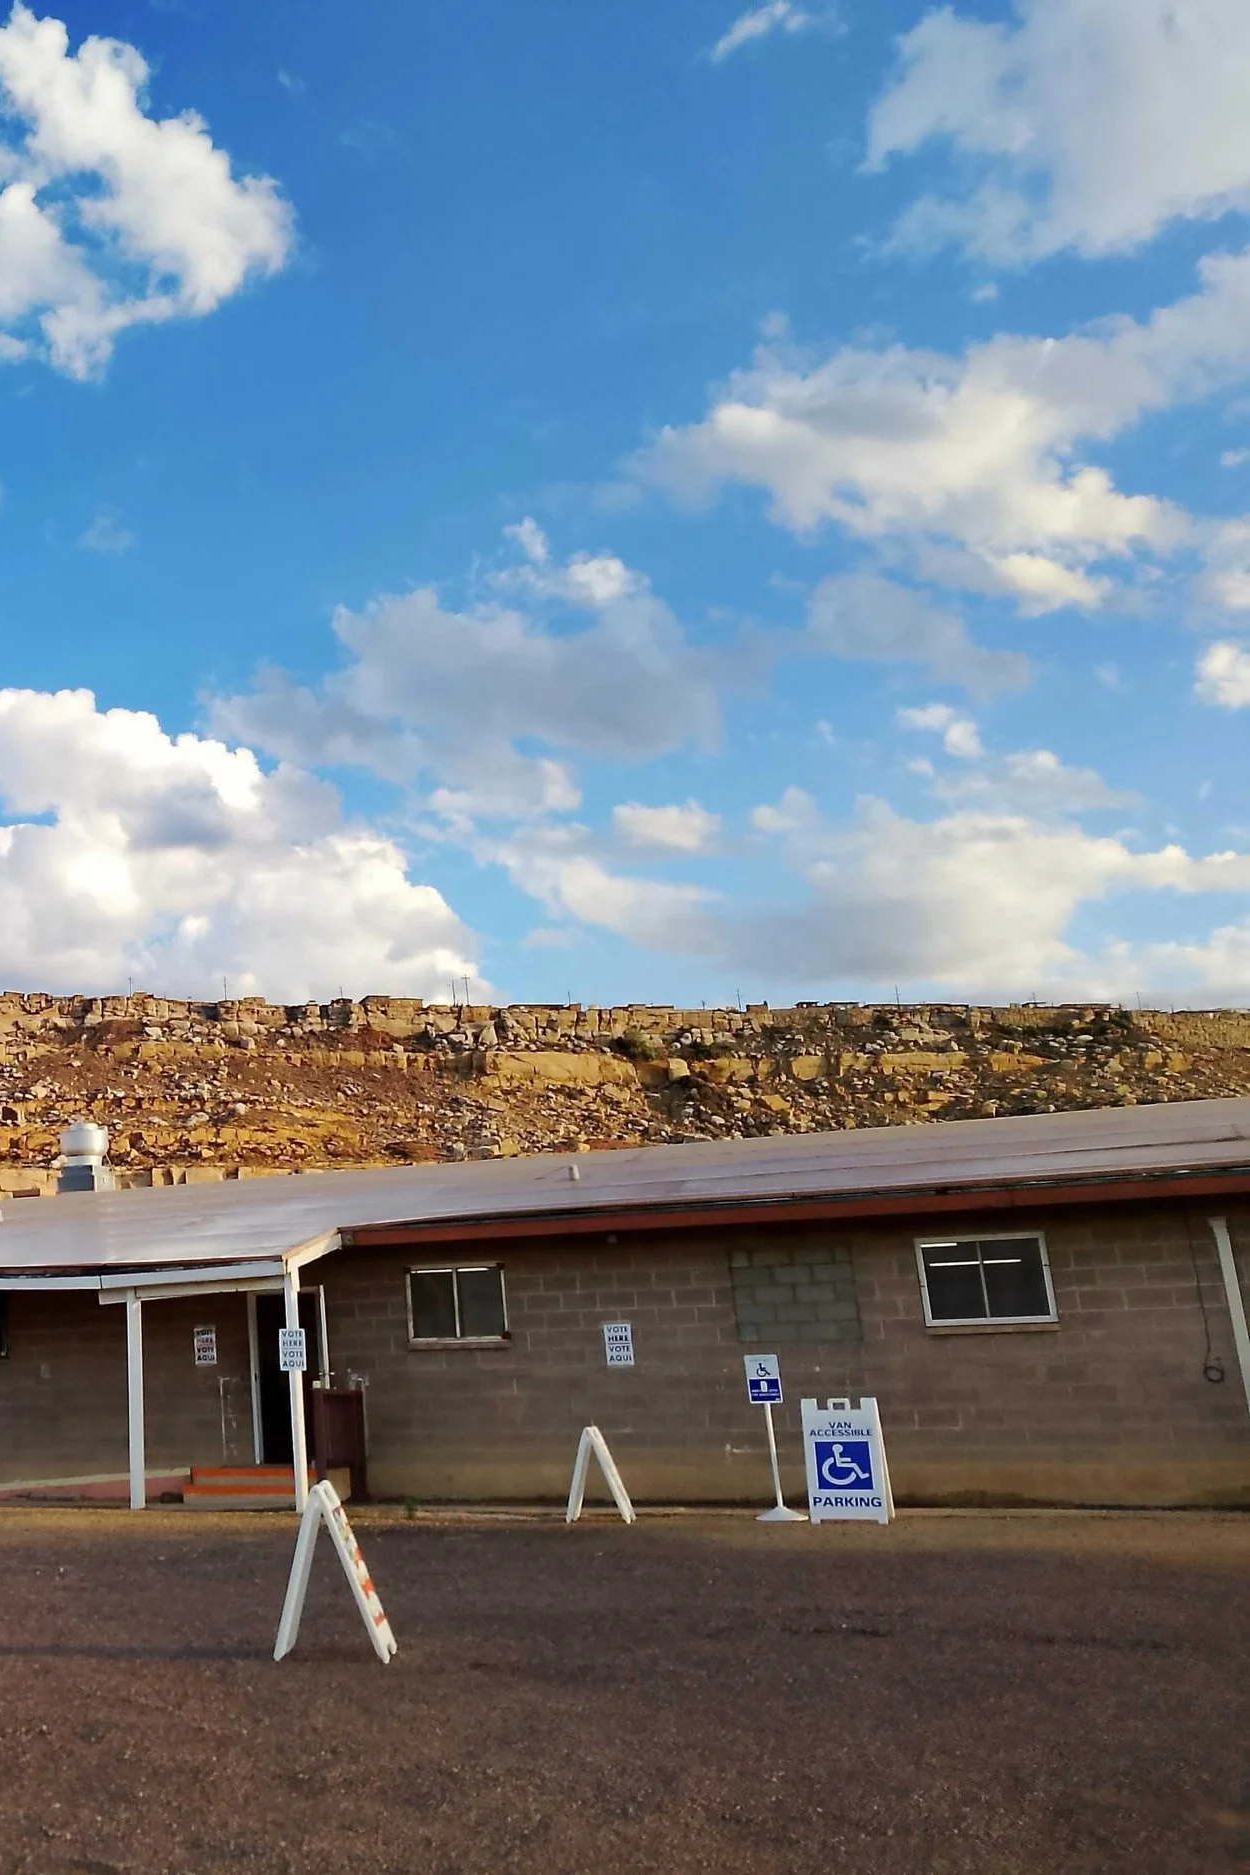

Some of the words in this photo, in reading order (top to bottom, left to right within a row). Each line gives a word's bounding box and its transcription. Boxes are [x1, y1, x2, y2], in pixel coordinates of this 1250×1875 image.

[281, 1330, 303, 1338] VOTE
[809, 1429, 873, 1437] ACCESSIBLE
[813, 1496, 882, 1507] PARKING
